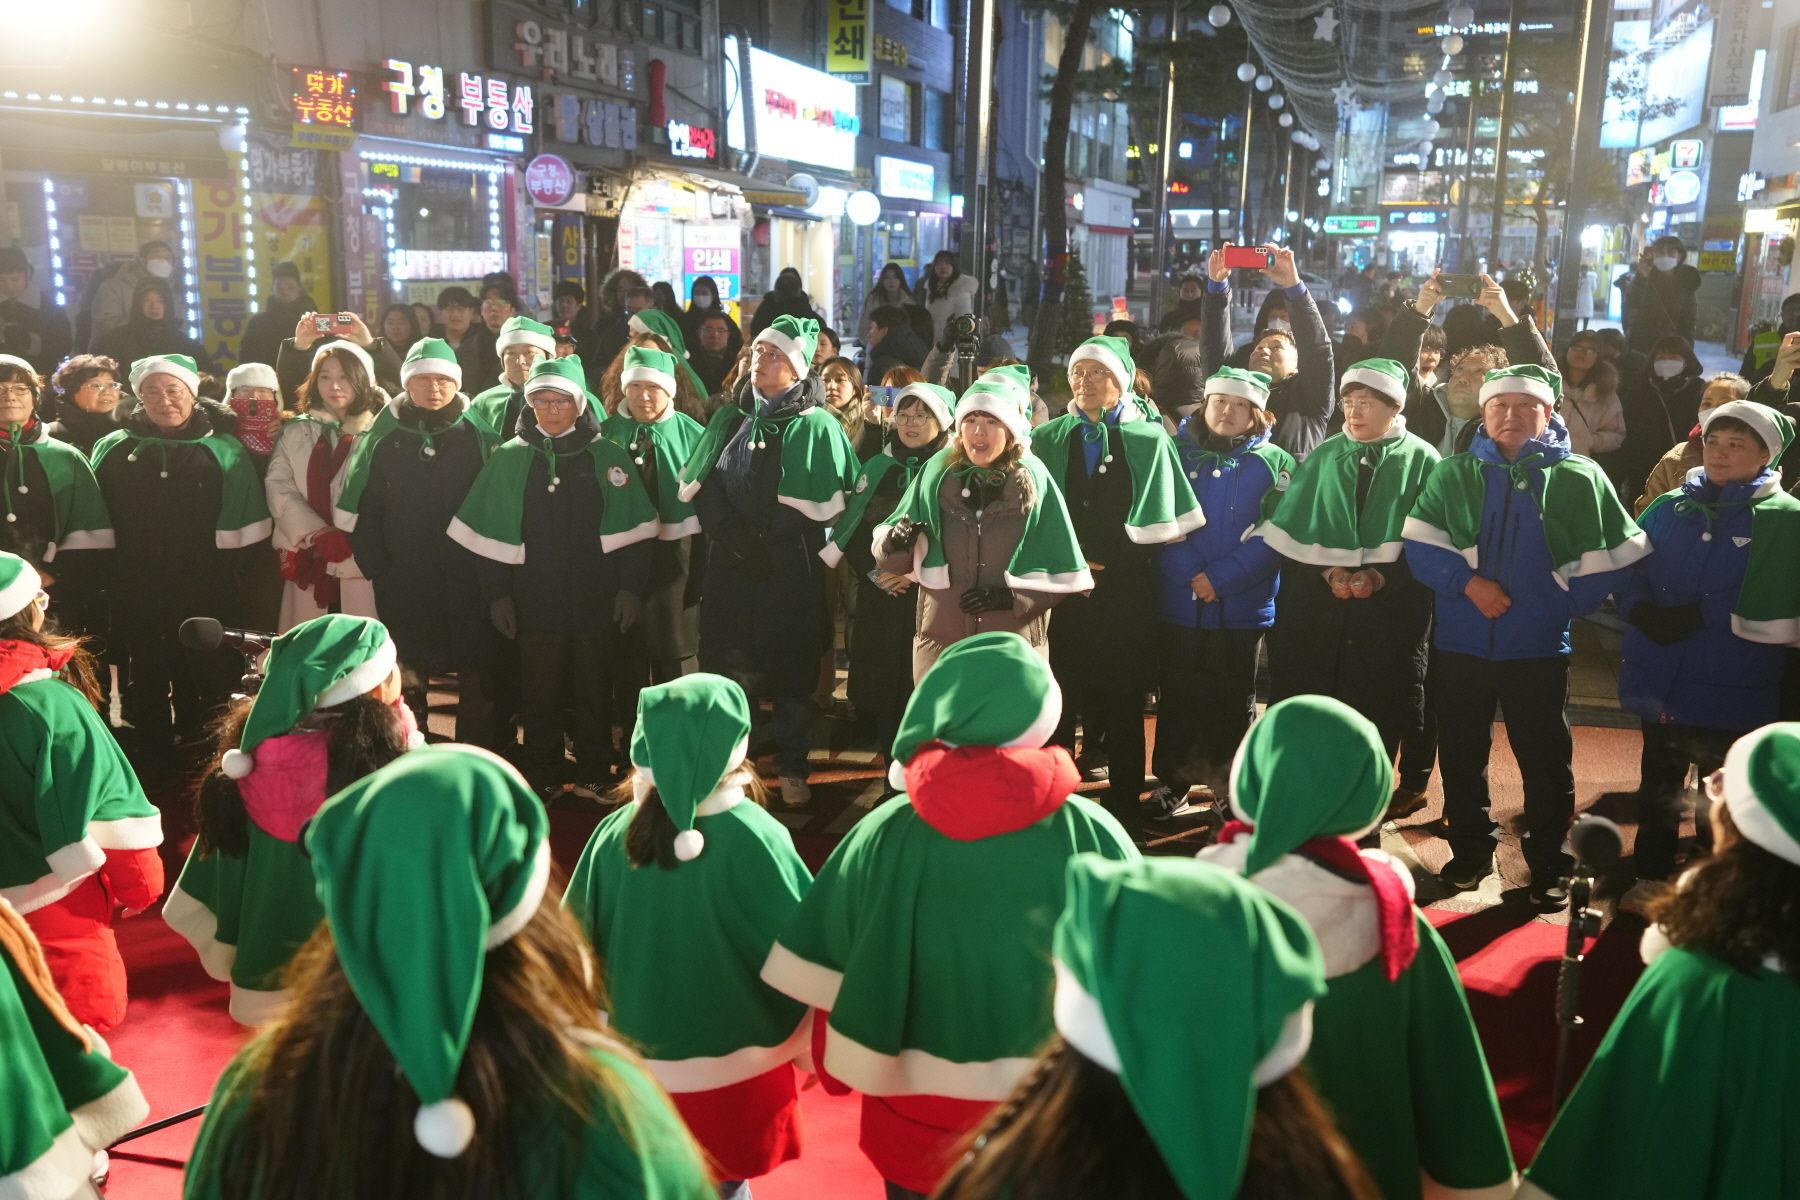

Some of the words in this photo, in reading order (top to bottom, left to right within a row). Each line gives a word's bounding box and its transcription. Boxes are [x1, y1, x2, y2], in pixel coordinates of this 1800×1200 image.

[382, 58, 445, 119] 구청
[456, 72, 534, 134] 부동산
[530, 179, 567, 195] 부동산
[691, 248, 732, 272] 인쇄
